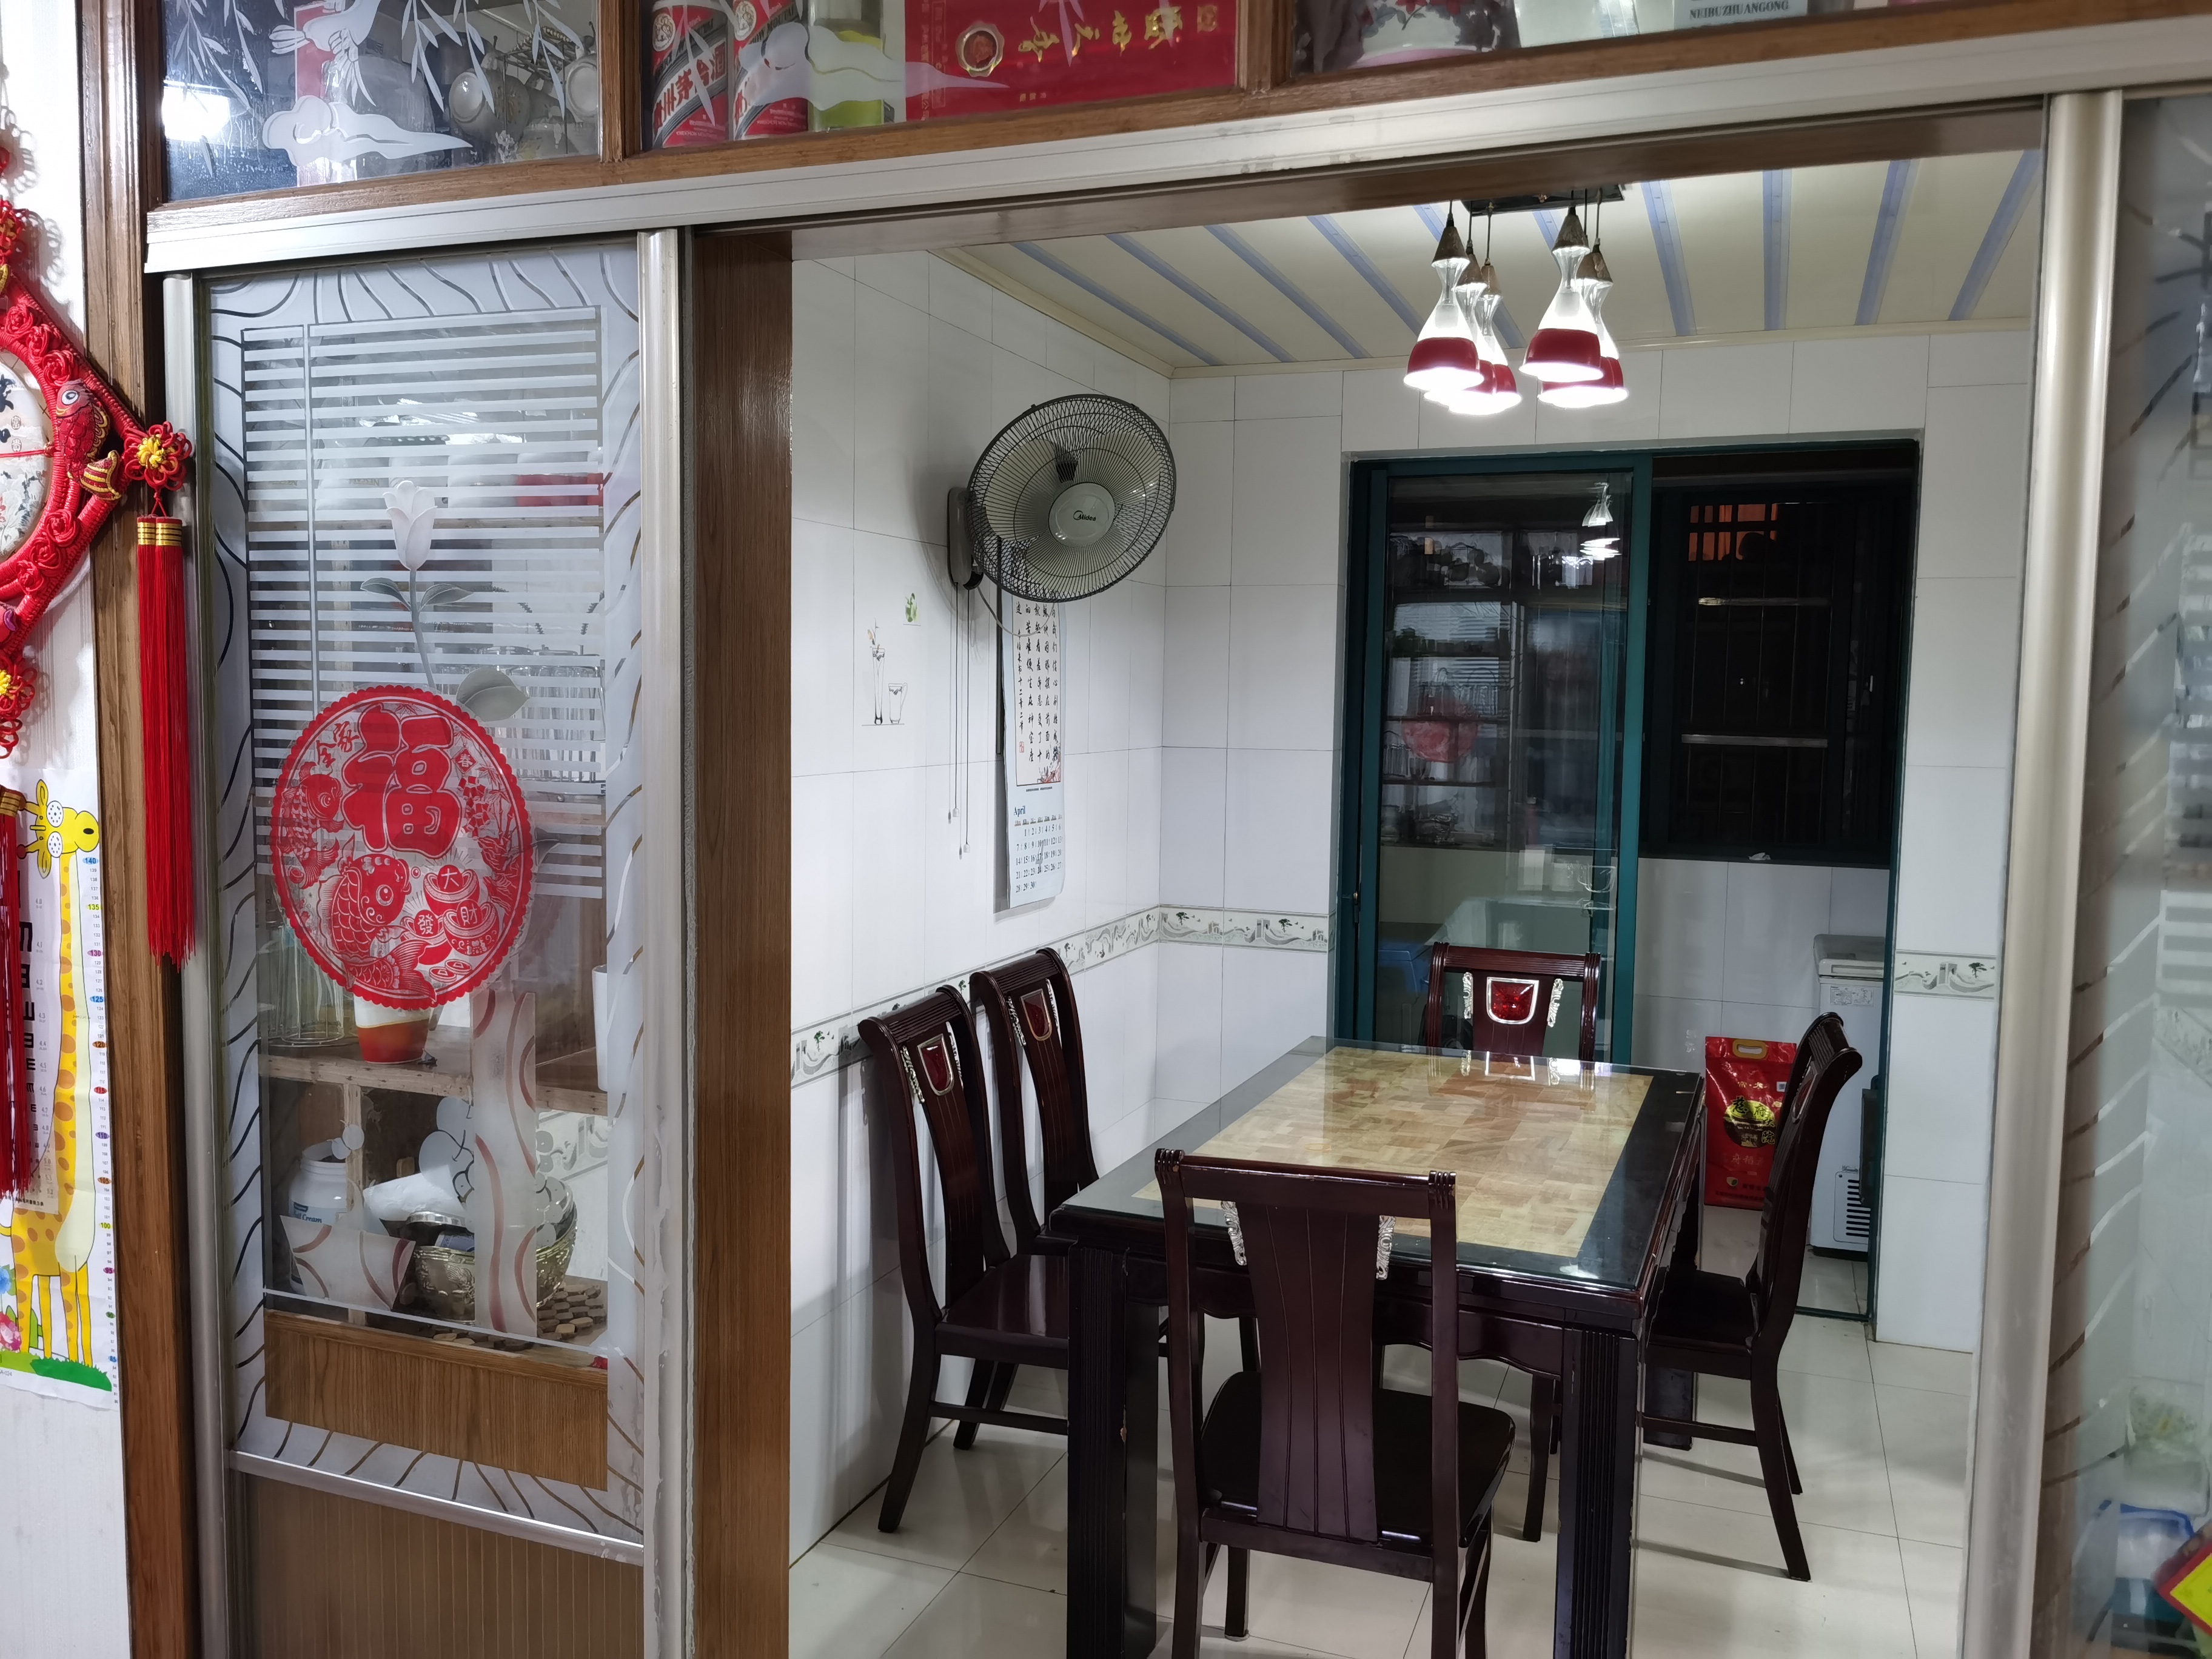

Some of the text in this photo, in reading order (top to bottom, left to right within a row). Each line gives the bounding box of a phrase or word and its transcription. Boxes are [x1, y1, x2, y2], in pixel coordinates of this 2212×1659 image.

[1689, 1, 1789, 19] NEIBUZHUANGONG
[1073, 510, 1096, 522] Midea
[458, 753, 474, 767] 春
[341, 703, 463, 859] 福
[1013, 805, 1026, 817] April
[441, 868, 459, 889] 大
[460, 903, 478, 926] 財
[418, 914, 434, 934] 發
[303, 1213, 322, 1223] Cream
